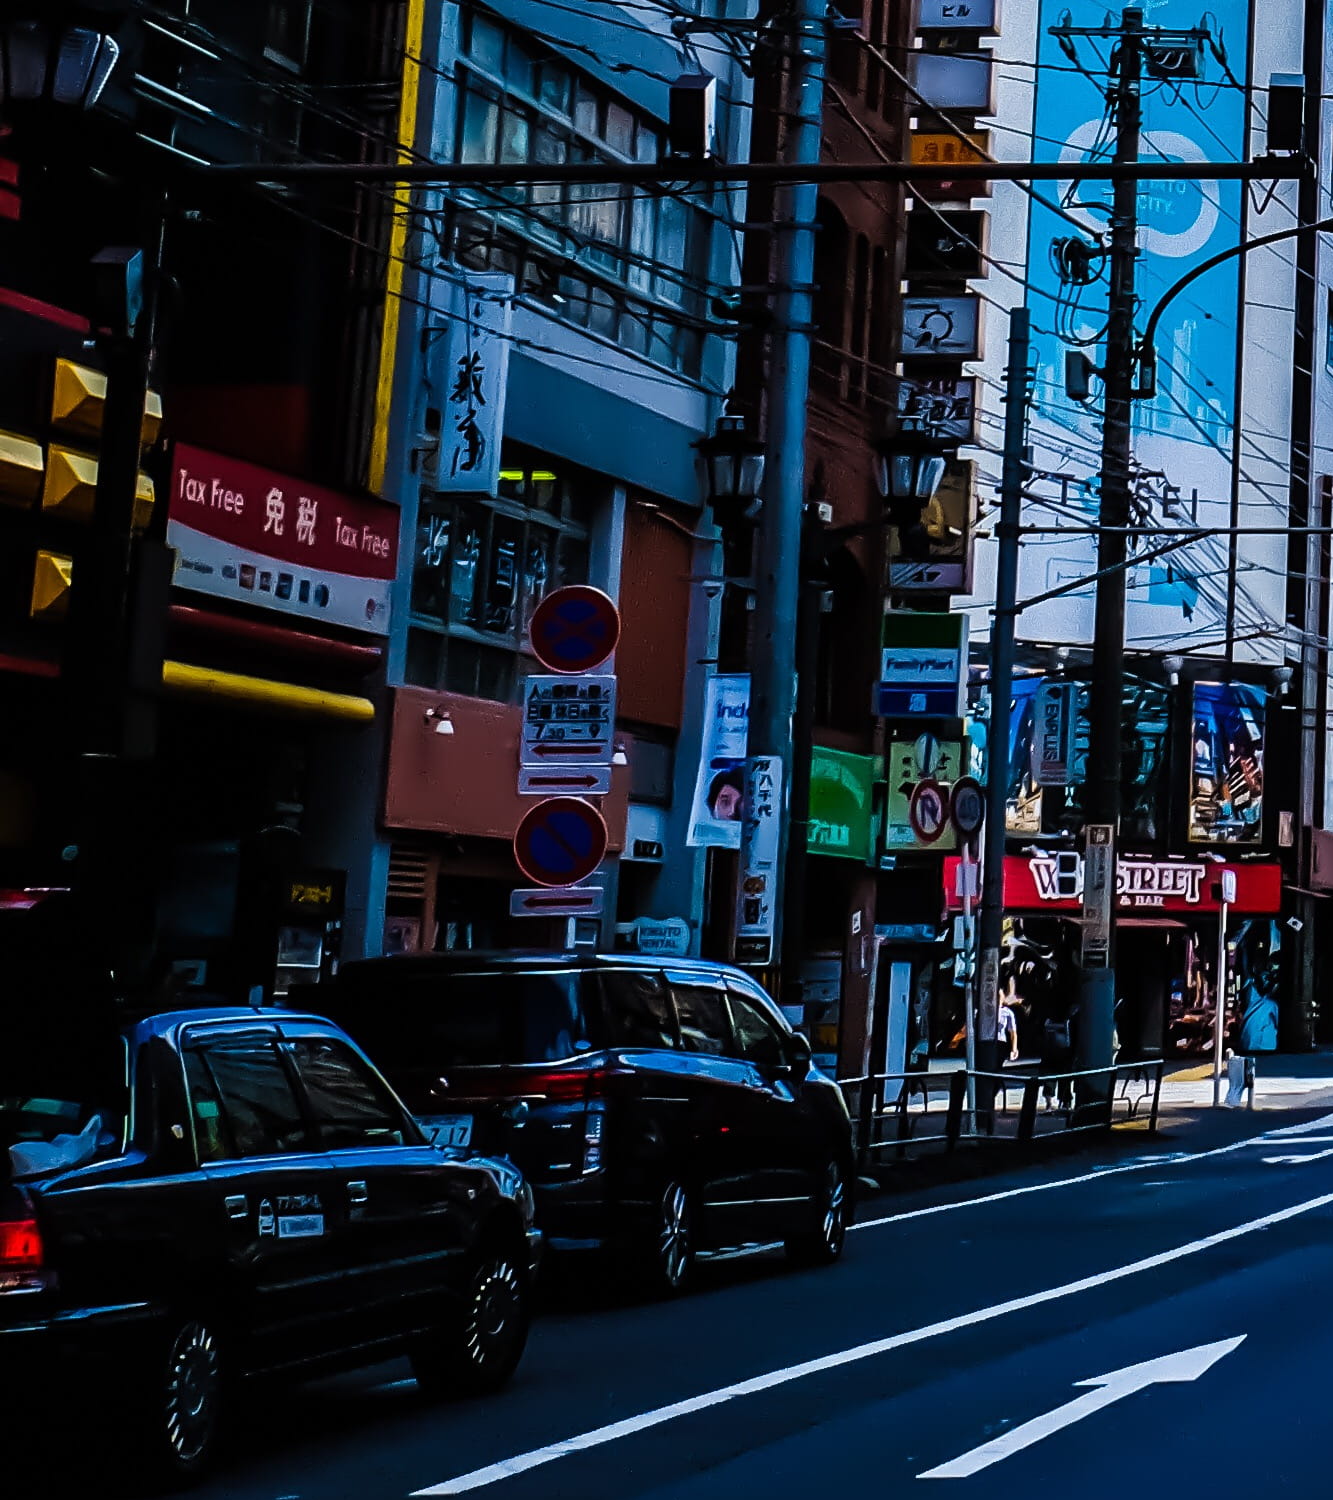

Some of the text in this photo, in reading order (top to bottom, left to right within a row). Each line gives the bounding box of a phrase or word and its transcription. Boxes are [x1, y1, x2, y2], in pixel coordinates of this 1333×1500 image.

[179, 468, 245, 516] Tax Free
[263, 487, 319, 546] 免税
[335, 516, 391, 558] Tax Free
[716, 701, 751, 719] ind
